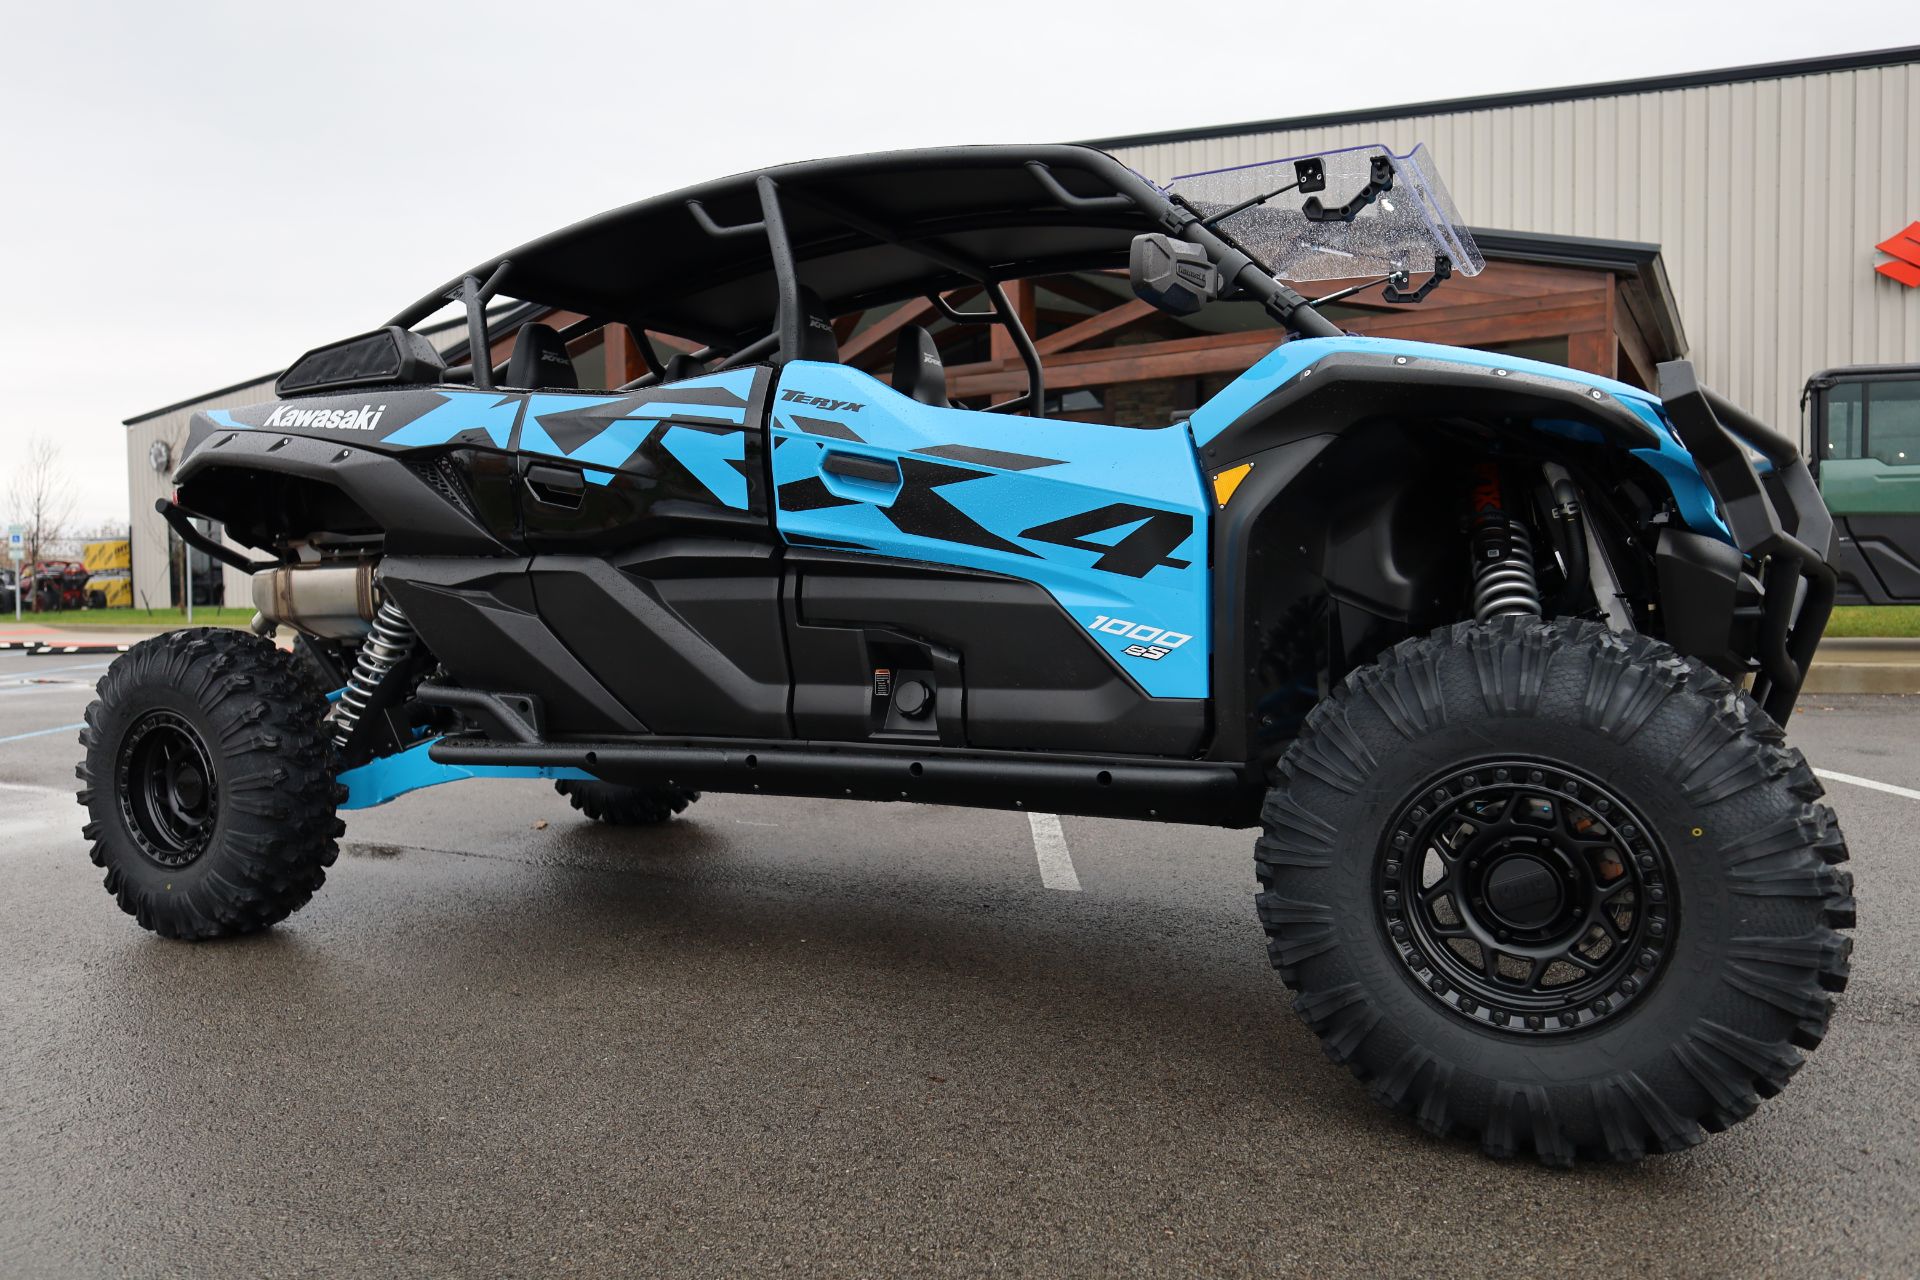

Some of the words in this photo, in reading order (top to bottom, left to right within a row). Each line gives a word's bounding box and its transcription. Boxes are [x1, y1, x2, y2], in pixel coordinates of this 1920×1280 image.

[263, 404, 387, 430] Kawasaki
[1017, 502, 1194, 579] 4
[1088, 615, 1193, 649] 1000
